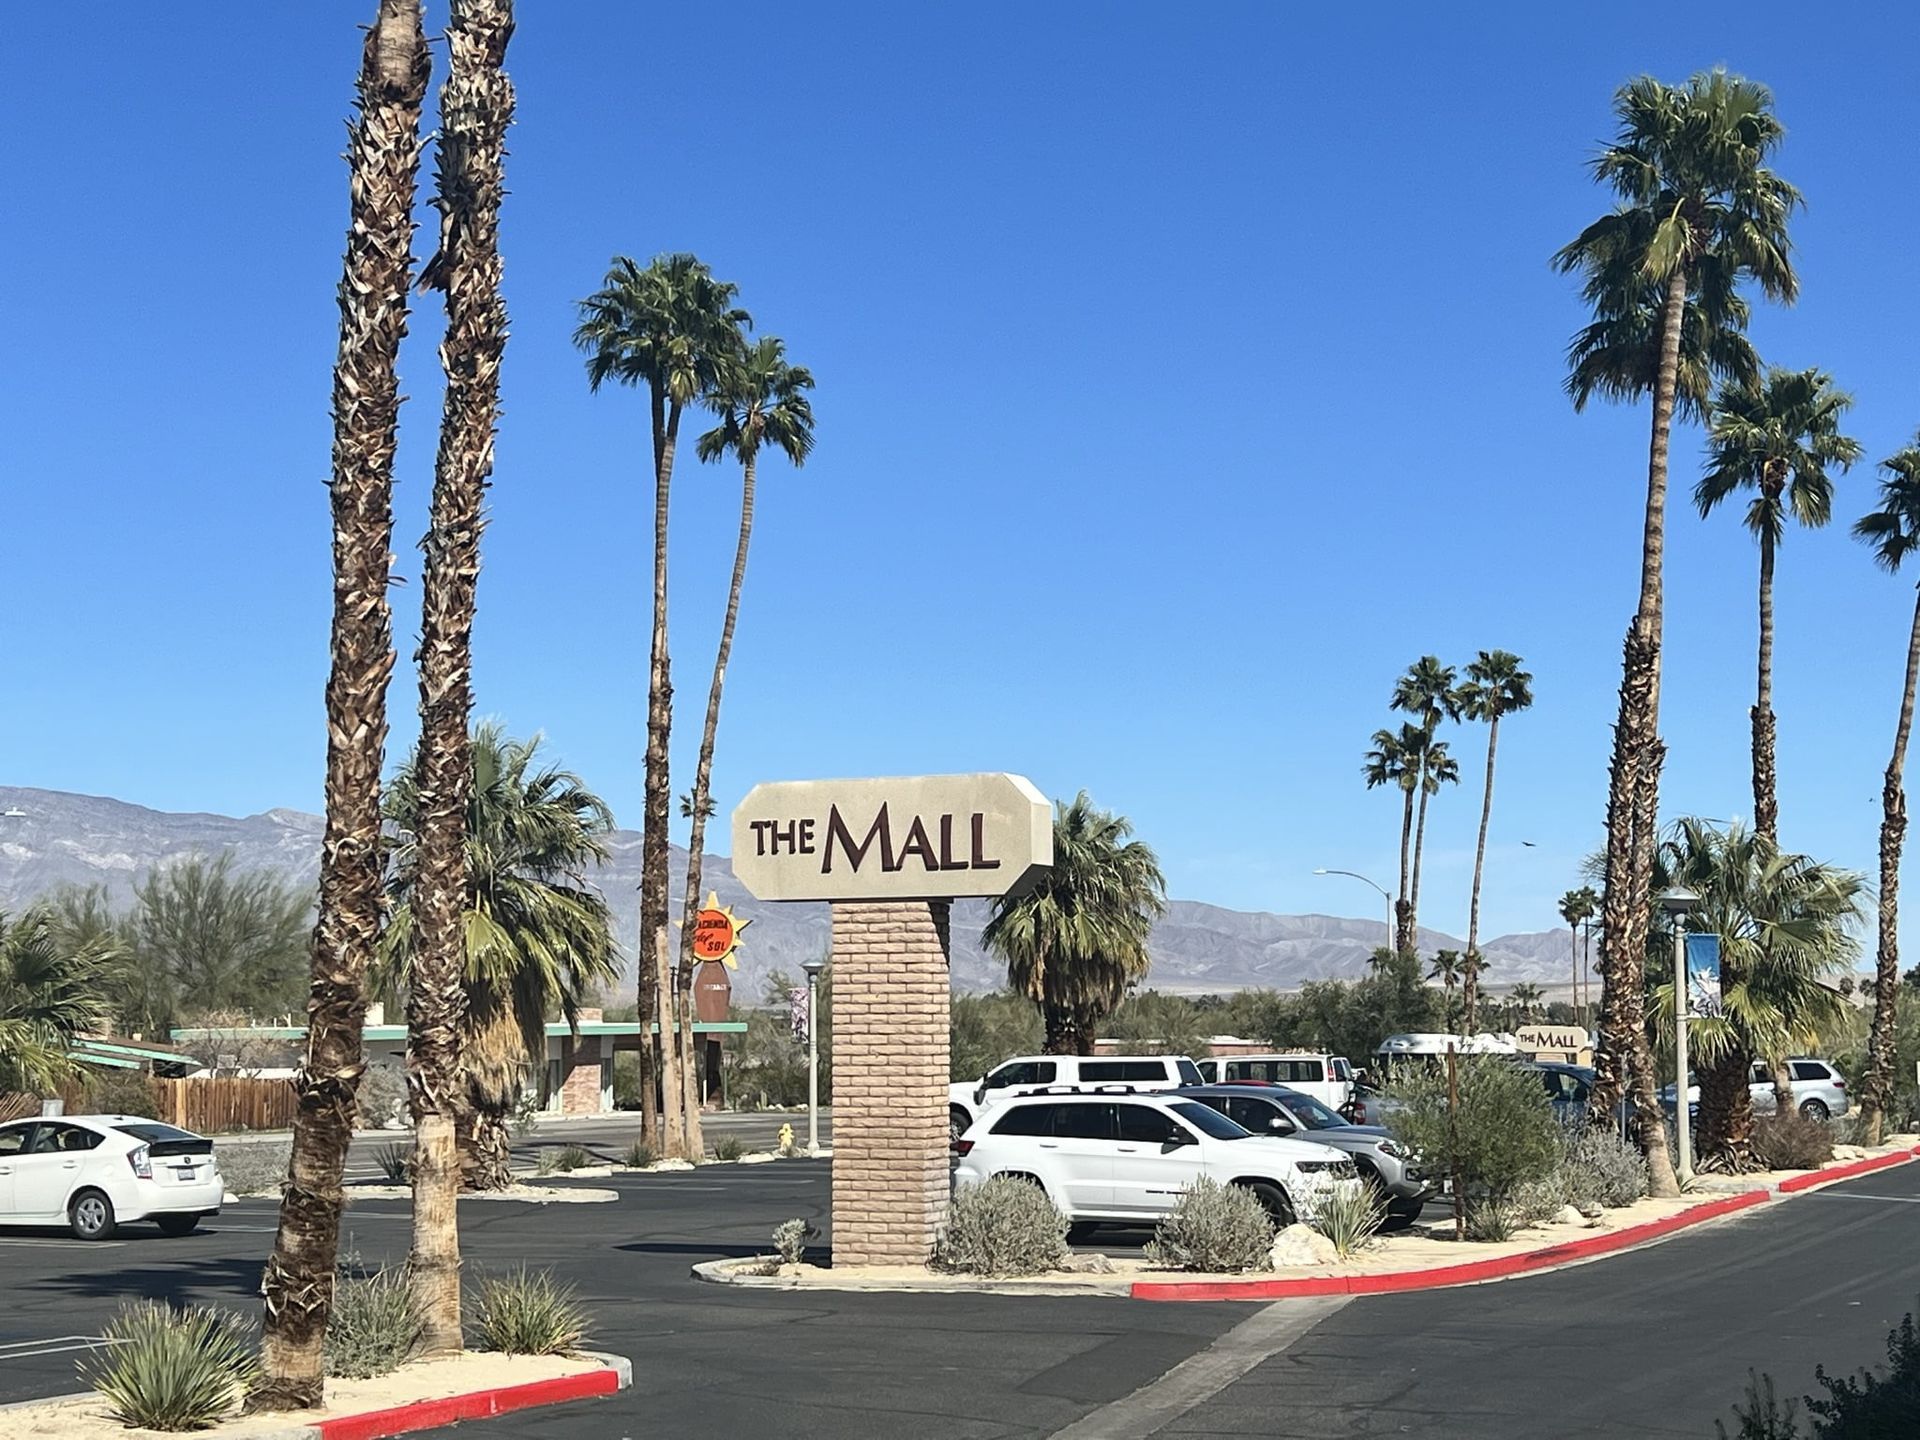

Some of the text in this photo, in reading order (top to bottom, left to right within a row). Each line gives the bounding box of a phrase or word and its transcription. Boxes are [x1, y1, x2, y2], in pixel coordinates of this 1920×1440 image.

[750, 801, 1001, 874] THE MALL
[698, 919, 728, 930] ACIENDA
[707, 941, 726, 951] SOL
[1520, 1031, 1578, 1048] THE MALL
